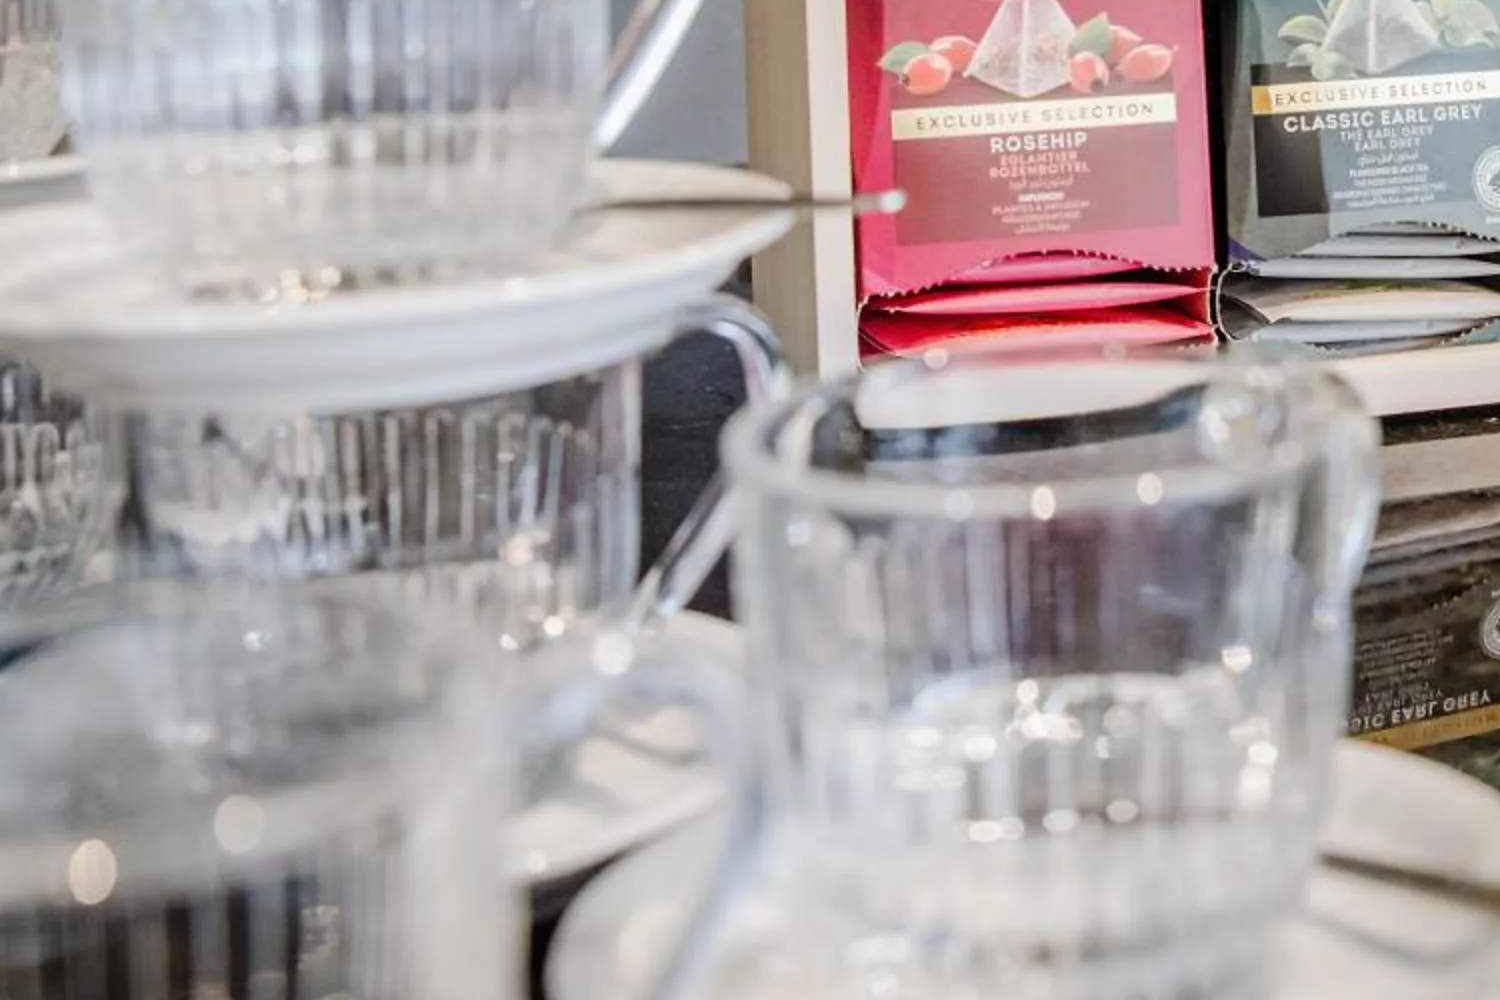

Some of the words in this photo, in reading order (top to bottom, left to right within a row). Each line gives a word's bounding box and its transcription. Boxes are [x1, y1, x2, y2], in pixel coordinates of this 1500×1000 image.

[1274, 86, 1379, 106] EXCLUSIVE
[1388, 79, 1487, 98] SELECTION
[916, 113, 1032, 132] EXCLUSIVE
[1041, 103, 1154, 122] SELECTION
[1283, 110, 1375, 134] CLASSIC
[1380, 108, 1430, 126] EARL
[1433, 103, 1483, 122] GREY
[989, 131, 1089, 153] ROSEHIP
[1366, 127, 1398, 141] EARL
[1401, 124, 1435, 138] GREY
[1355, 139, 1386, 153] EARL
[1389, 137, 1421, 150] GREY
